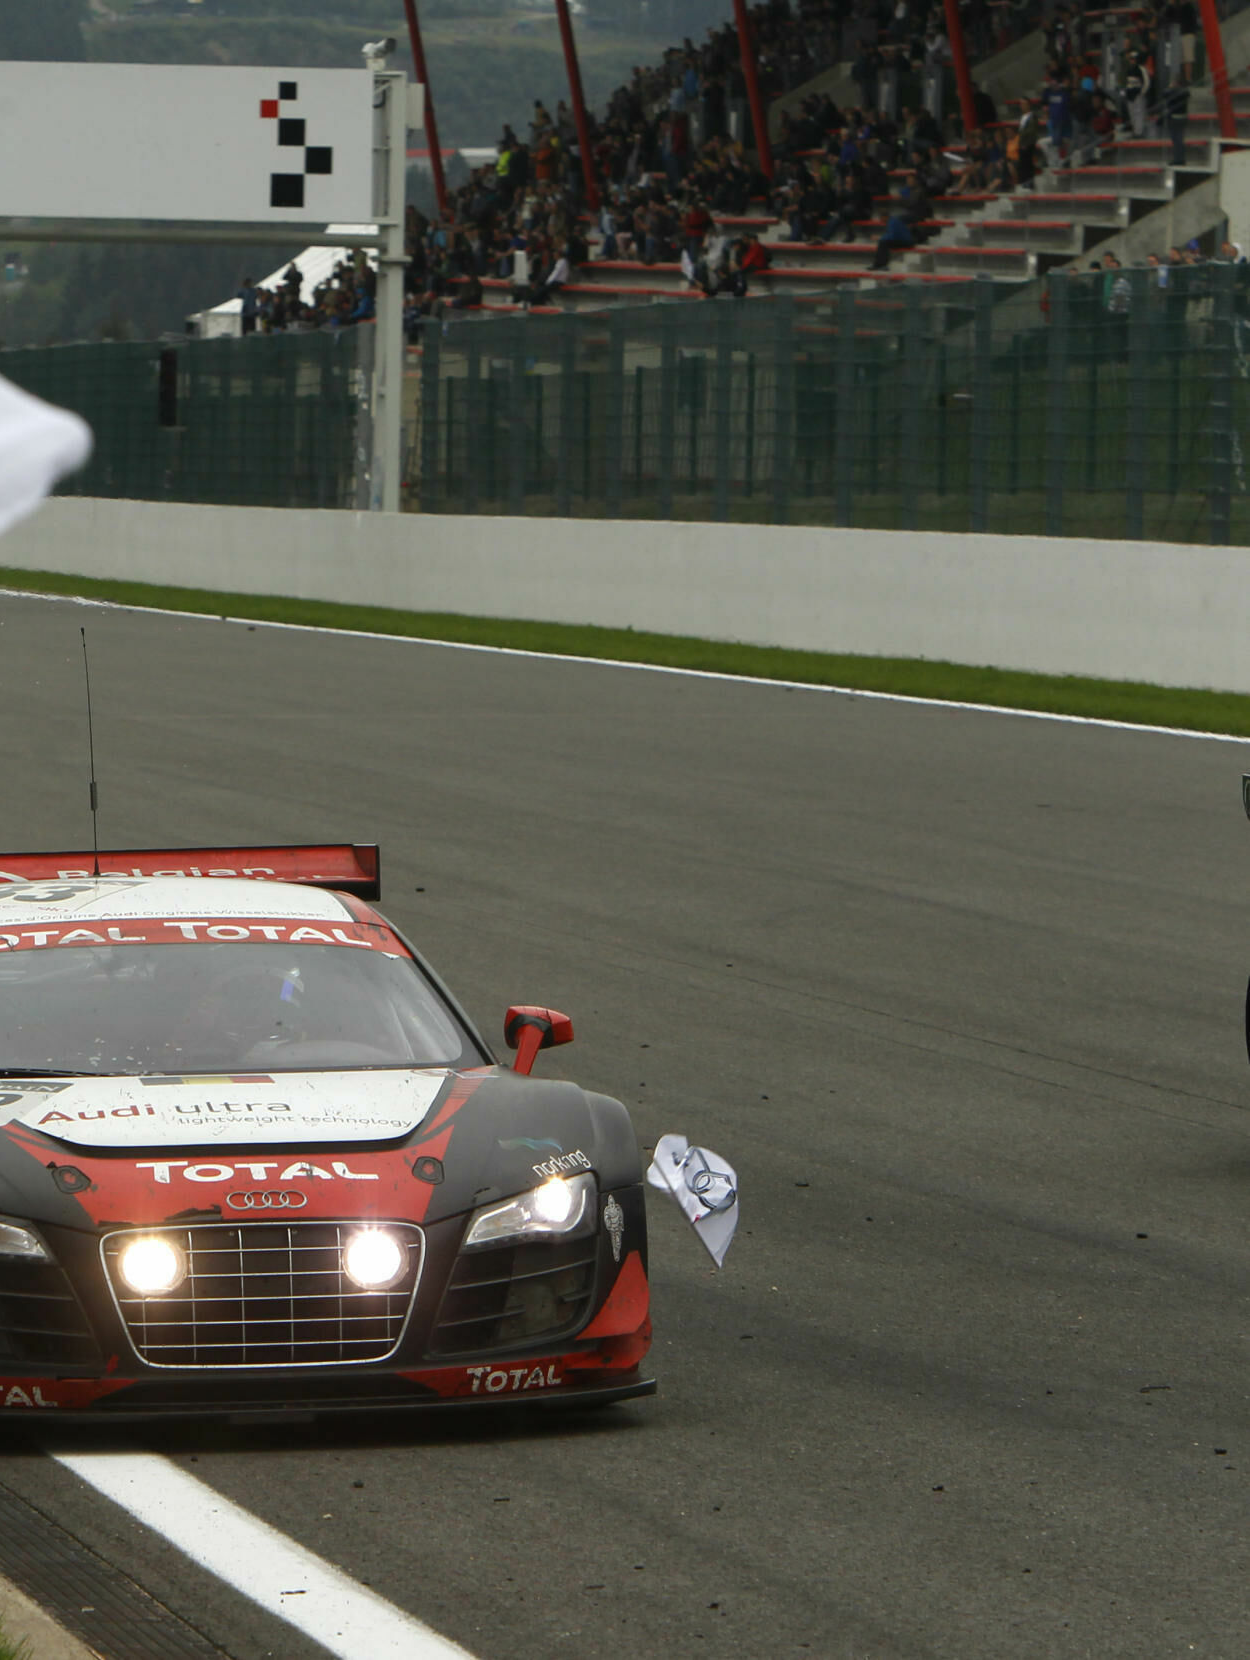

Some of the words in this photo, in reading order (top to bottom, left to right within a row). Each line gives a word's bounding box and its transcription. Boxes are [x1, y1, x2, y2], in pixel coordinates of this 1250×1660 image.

[163, 921, 372, 947] TOTAL
[38, 1104, 155, 1124] Audi
[175, 1101, 291, 1113] ultra
[178, 1116, 294, 1125] lightweight
[302, 1116, 412, 1128] technology
[136, 1161, 379, 1184] TOTAL
[467, 1364, 562, 1392] TOTAL
